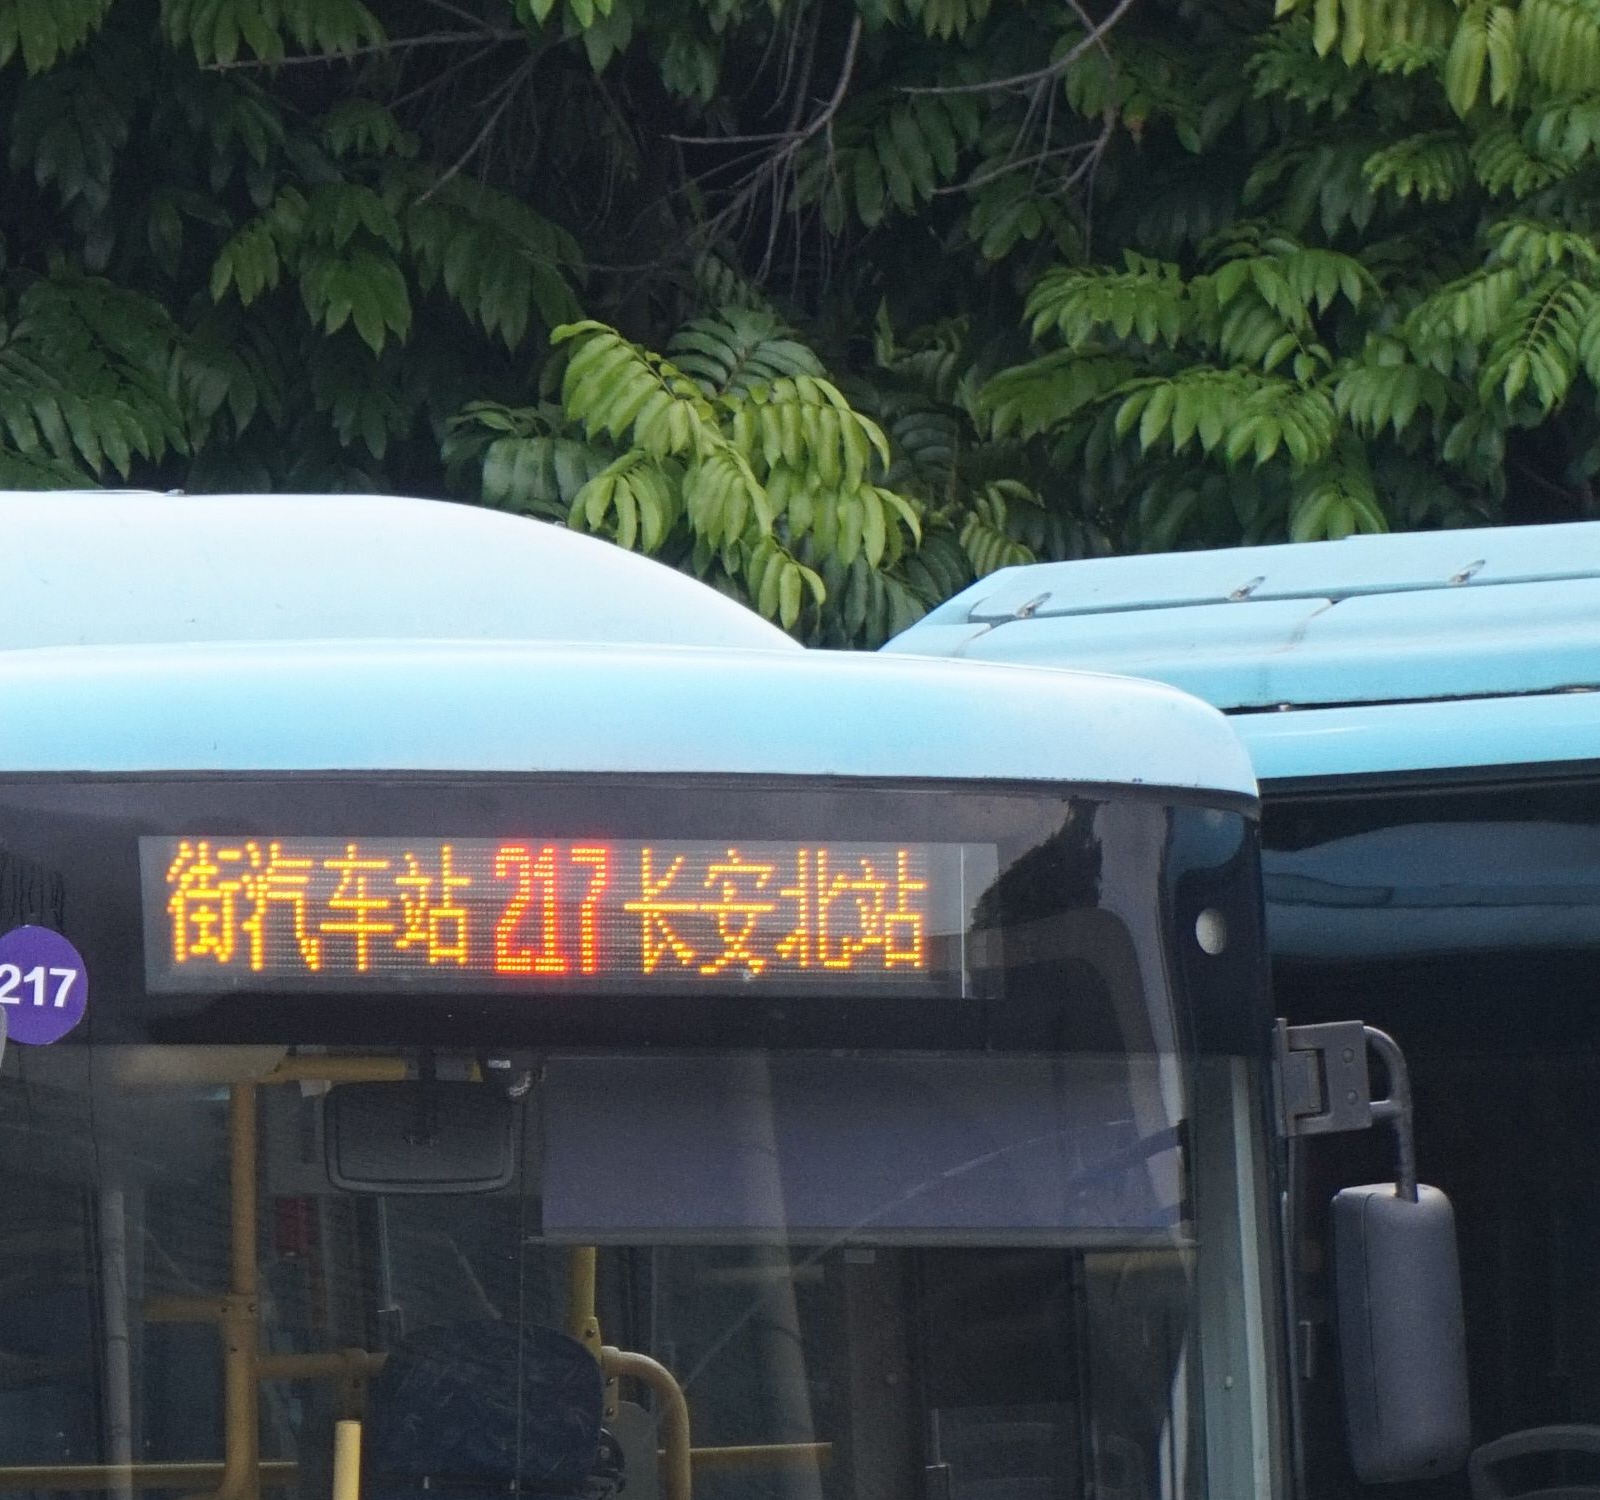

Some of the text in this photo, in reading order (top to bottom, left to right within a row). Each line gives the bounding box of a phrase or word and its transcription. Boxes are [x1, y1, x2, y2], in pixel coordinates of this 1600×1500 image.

[165, 841, 929, 975] 街汽车站 217 长安北站
